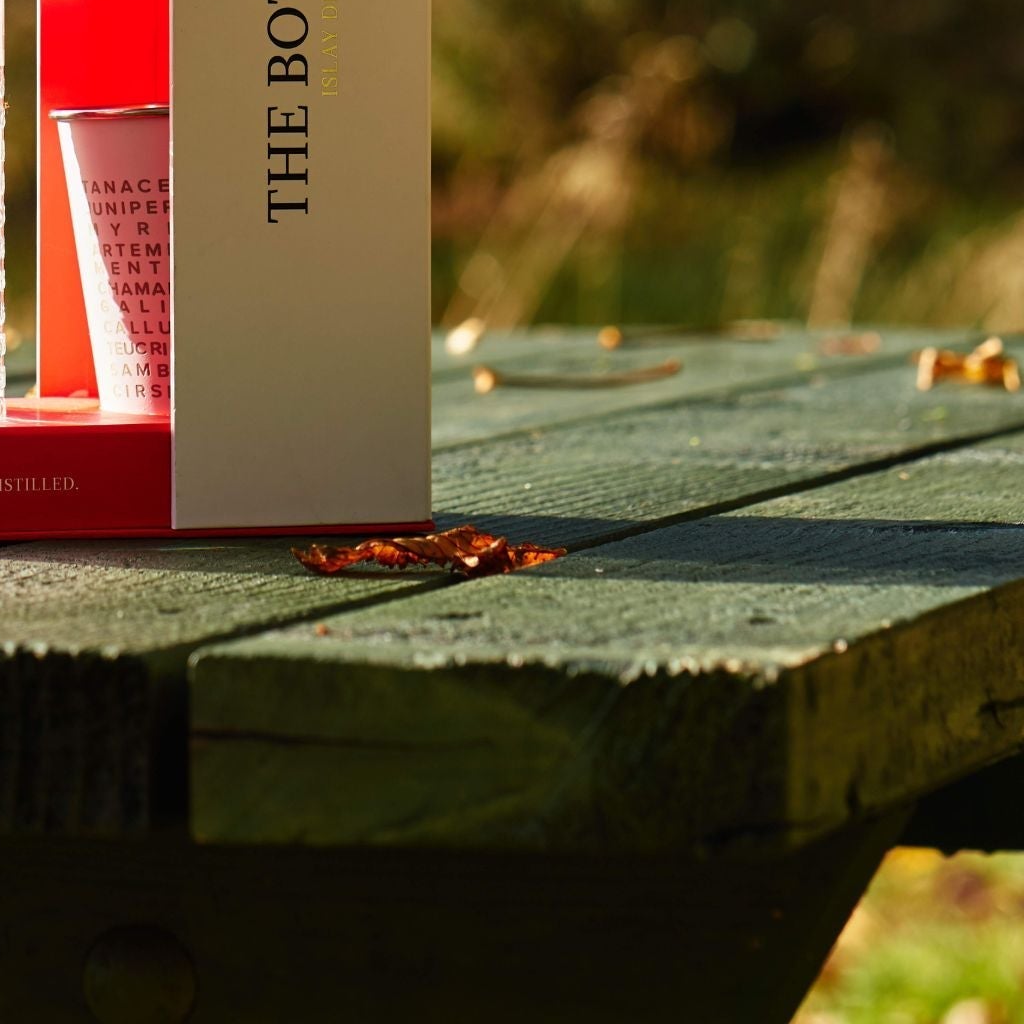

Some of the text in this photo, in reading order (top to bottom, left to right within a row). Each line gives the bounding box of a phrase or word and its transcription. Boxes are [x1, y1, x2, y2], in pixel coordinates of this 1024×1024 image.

[319, 30, 338, 97] ISLAY
[266, 105, 309, 224] THE
[88, 200, 170, 216] UNIPE
[97, 281, 170, 297] CHAMA
